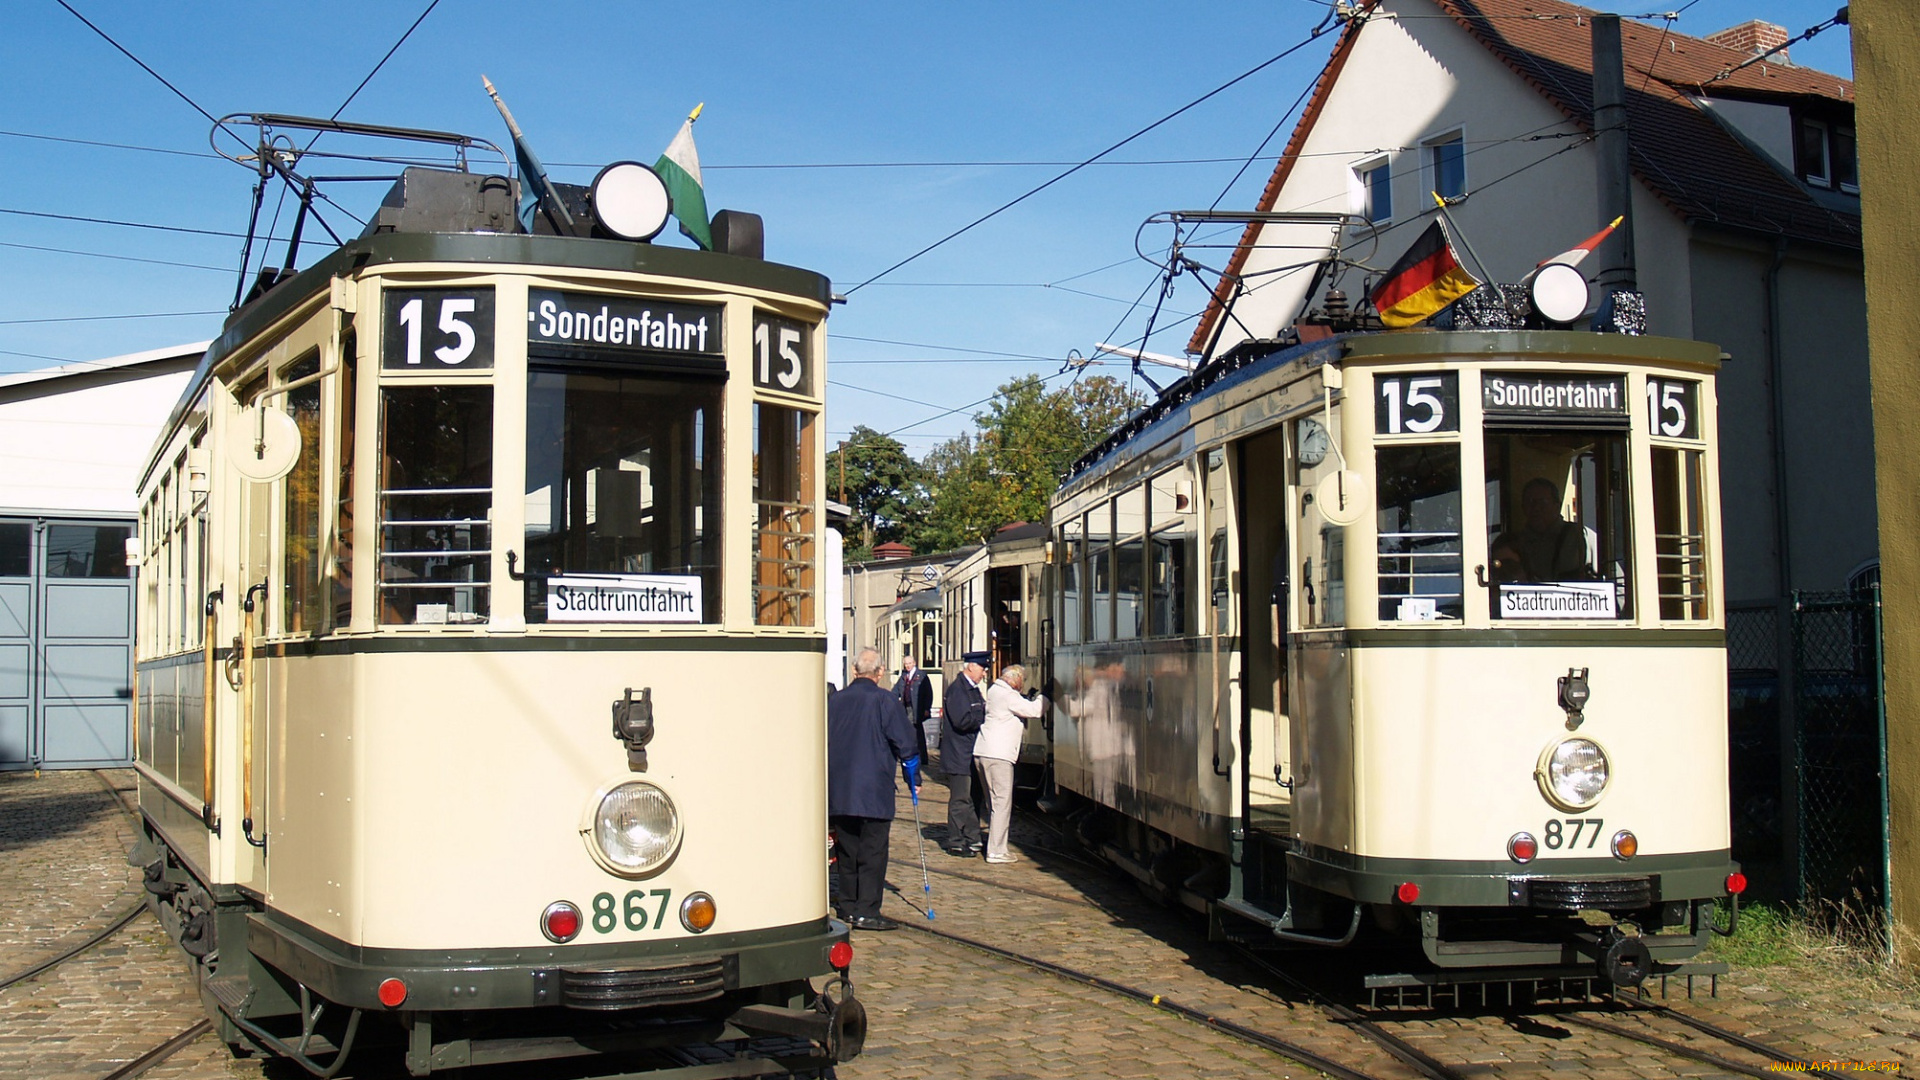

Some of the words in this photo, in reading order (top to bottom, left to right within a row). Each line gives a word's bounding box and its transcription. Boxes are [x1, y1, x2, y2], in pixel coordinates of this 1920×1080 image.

[400, 299, 475, 364] 15
[755, 323, 801, 388] 15
[1383, 379, 1443, 433] 15
[1646, 380, 1687, 437] 15
[556, 585, 693, 613] Stadtrundfahrt
[1506, 590, 1609, 612] Stadtrundfahrt
[1544, 818, 1604, 850] 877
[592, 888, 671, 934] 867
